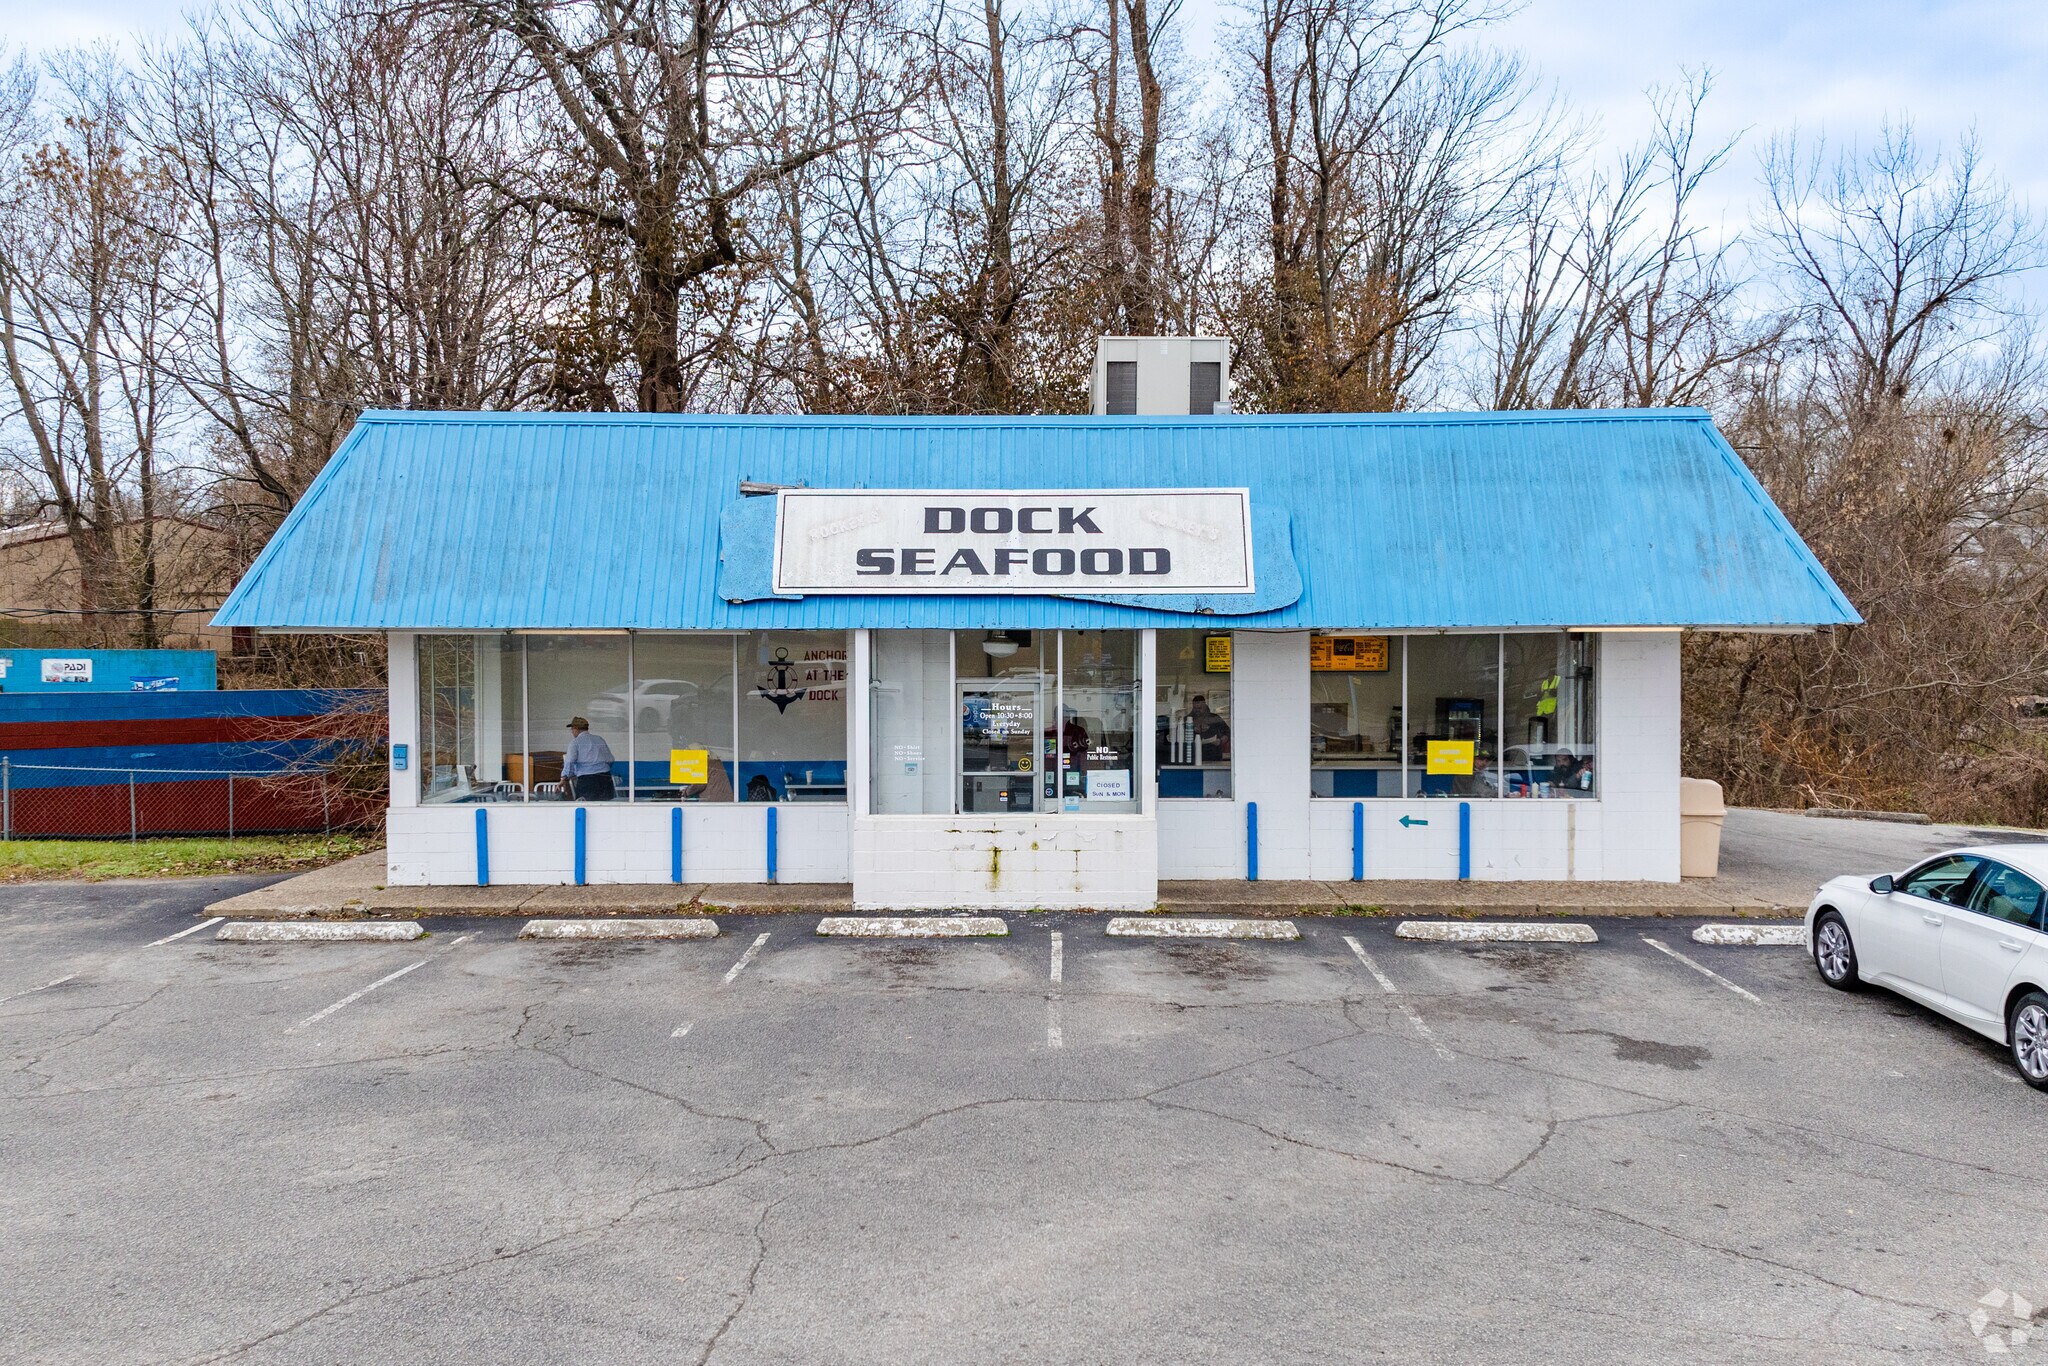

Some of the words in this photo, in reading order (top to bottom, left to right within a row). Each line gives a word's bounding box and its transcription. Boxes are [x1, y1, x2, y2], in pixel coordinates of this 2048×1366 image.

[924, 506, 1103, 534] DOCK
[856, 547, 1171, 576] SEAFOOD
[64, 663, 86, 671] PADI
[806, 670, 818, 681] AT
[824, 669, 844, 681] THE
[809, 690, 838, 701] DOCK
[992, 703, 1021, 711] Hours
[980, 712, 996, 720] Open
[1096, 746, 1109, 754] NO
